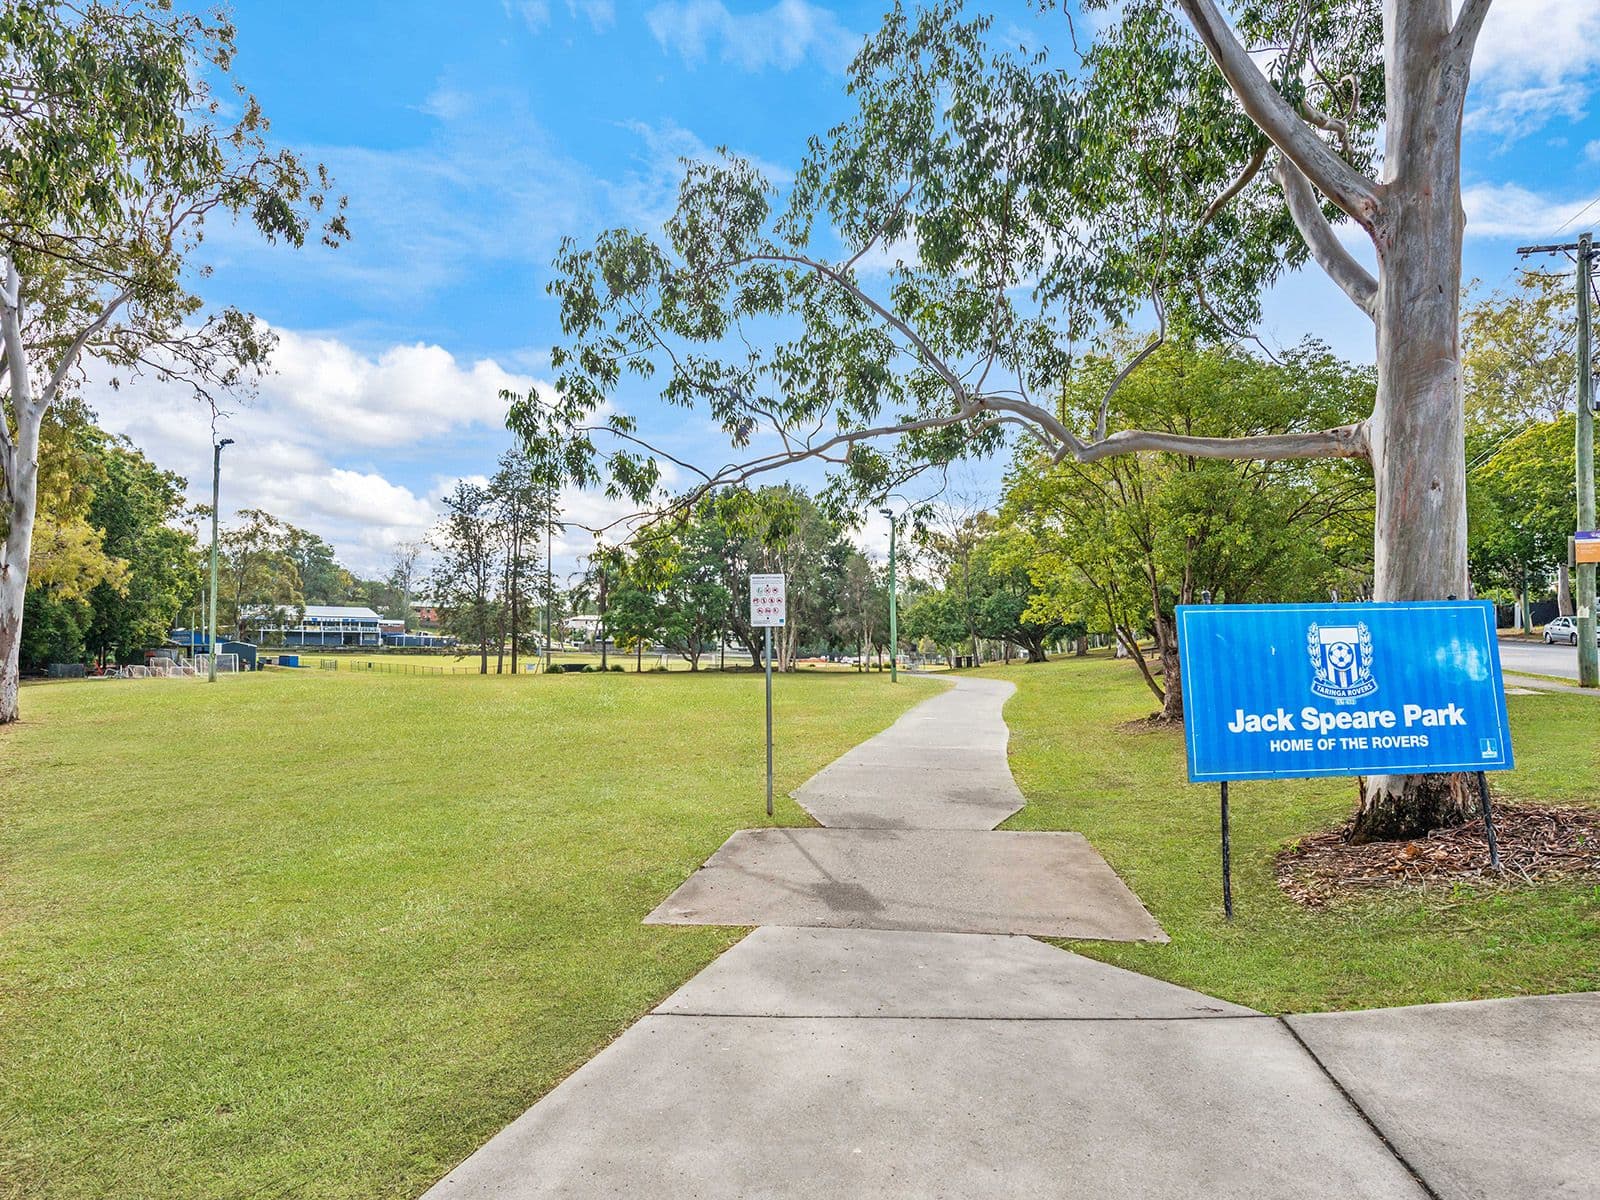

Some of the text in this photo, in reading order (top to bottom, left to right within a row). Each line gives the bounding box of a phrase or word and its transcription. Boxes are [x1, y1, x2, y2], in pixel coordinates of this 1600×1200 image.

[1316, 684, 1373, 697] TARINGA ROVERS
[1228, 703, 1467, 735] Jack Speare Park
[1270, 735, 1429, 752] HOME OF THE ROVERS
